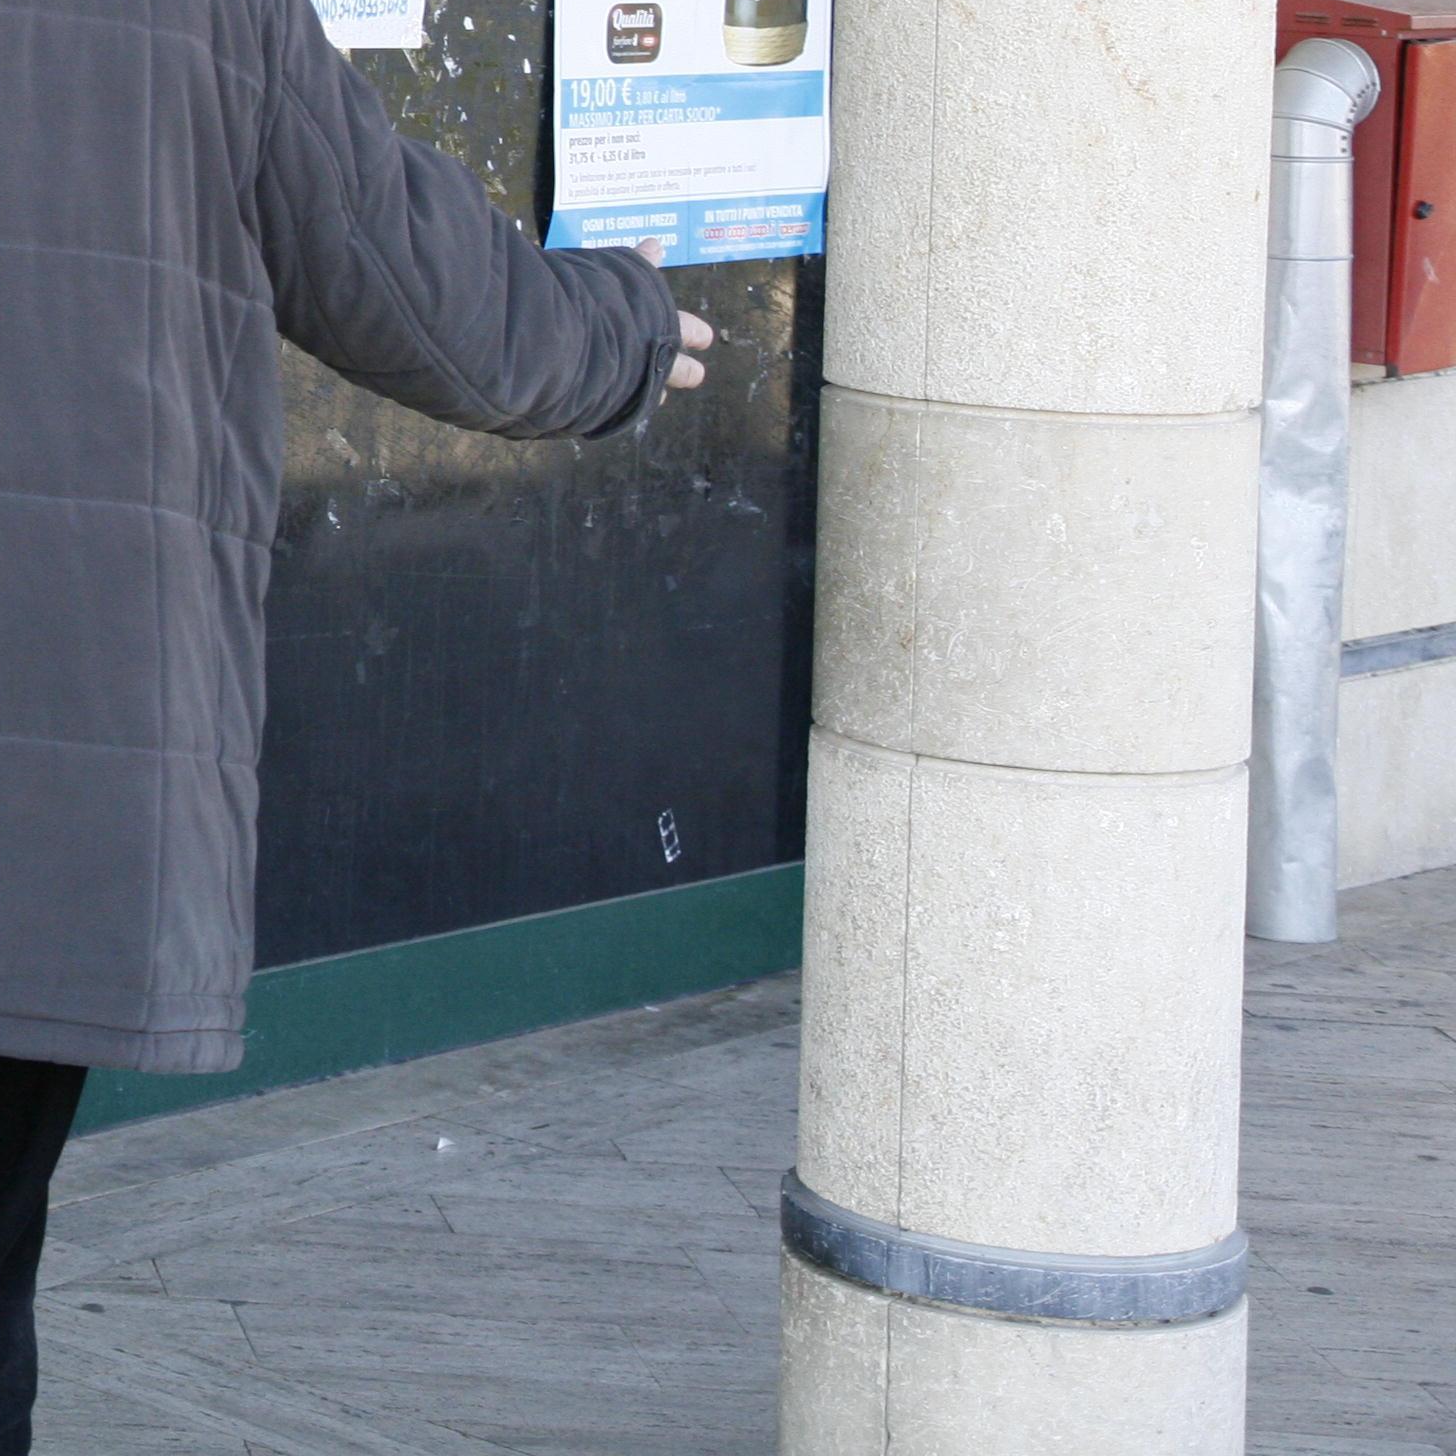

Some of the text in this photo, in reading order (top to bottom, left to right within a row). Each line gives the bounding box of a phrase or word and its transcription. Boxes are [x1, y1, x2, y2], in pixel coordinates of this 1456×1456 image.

[612, 8, 655, 31] Qualità
[570, 78, 616, 111] 19,00
[621, 78, 633, 106] €
[569, 111, 613, 128] MASSIMO
[615, 111, 622, 126] 2
[638, 109, 654, 125] PER
[656, 108, 684, 124] CARTA
